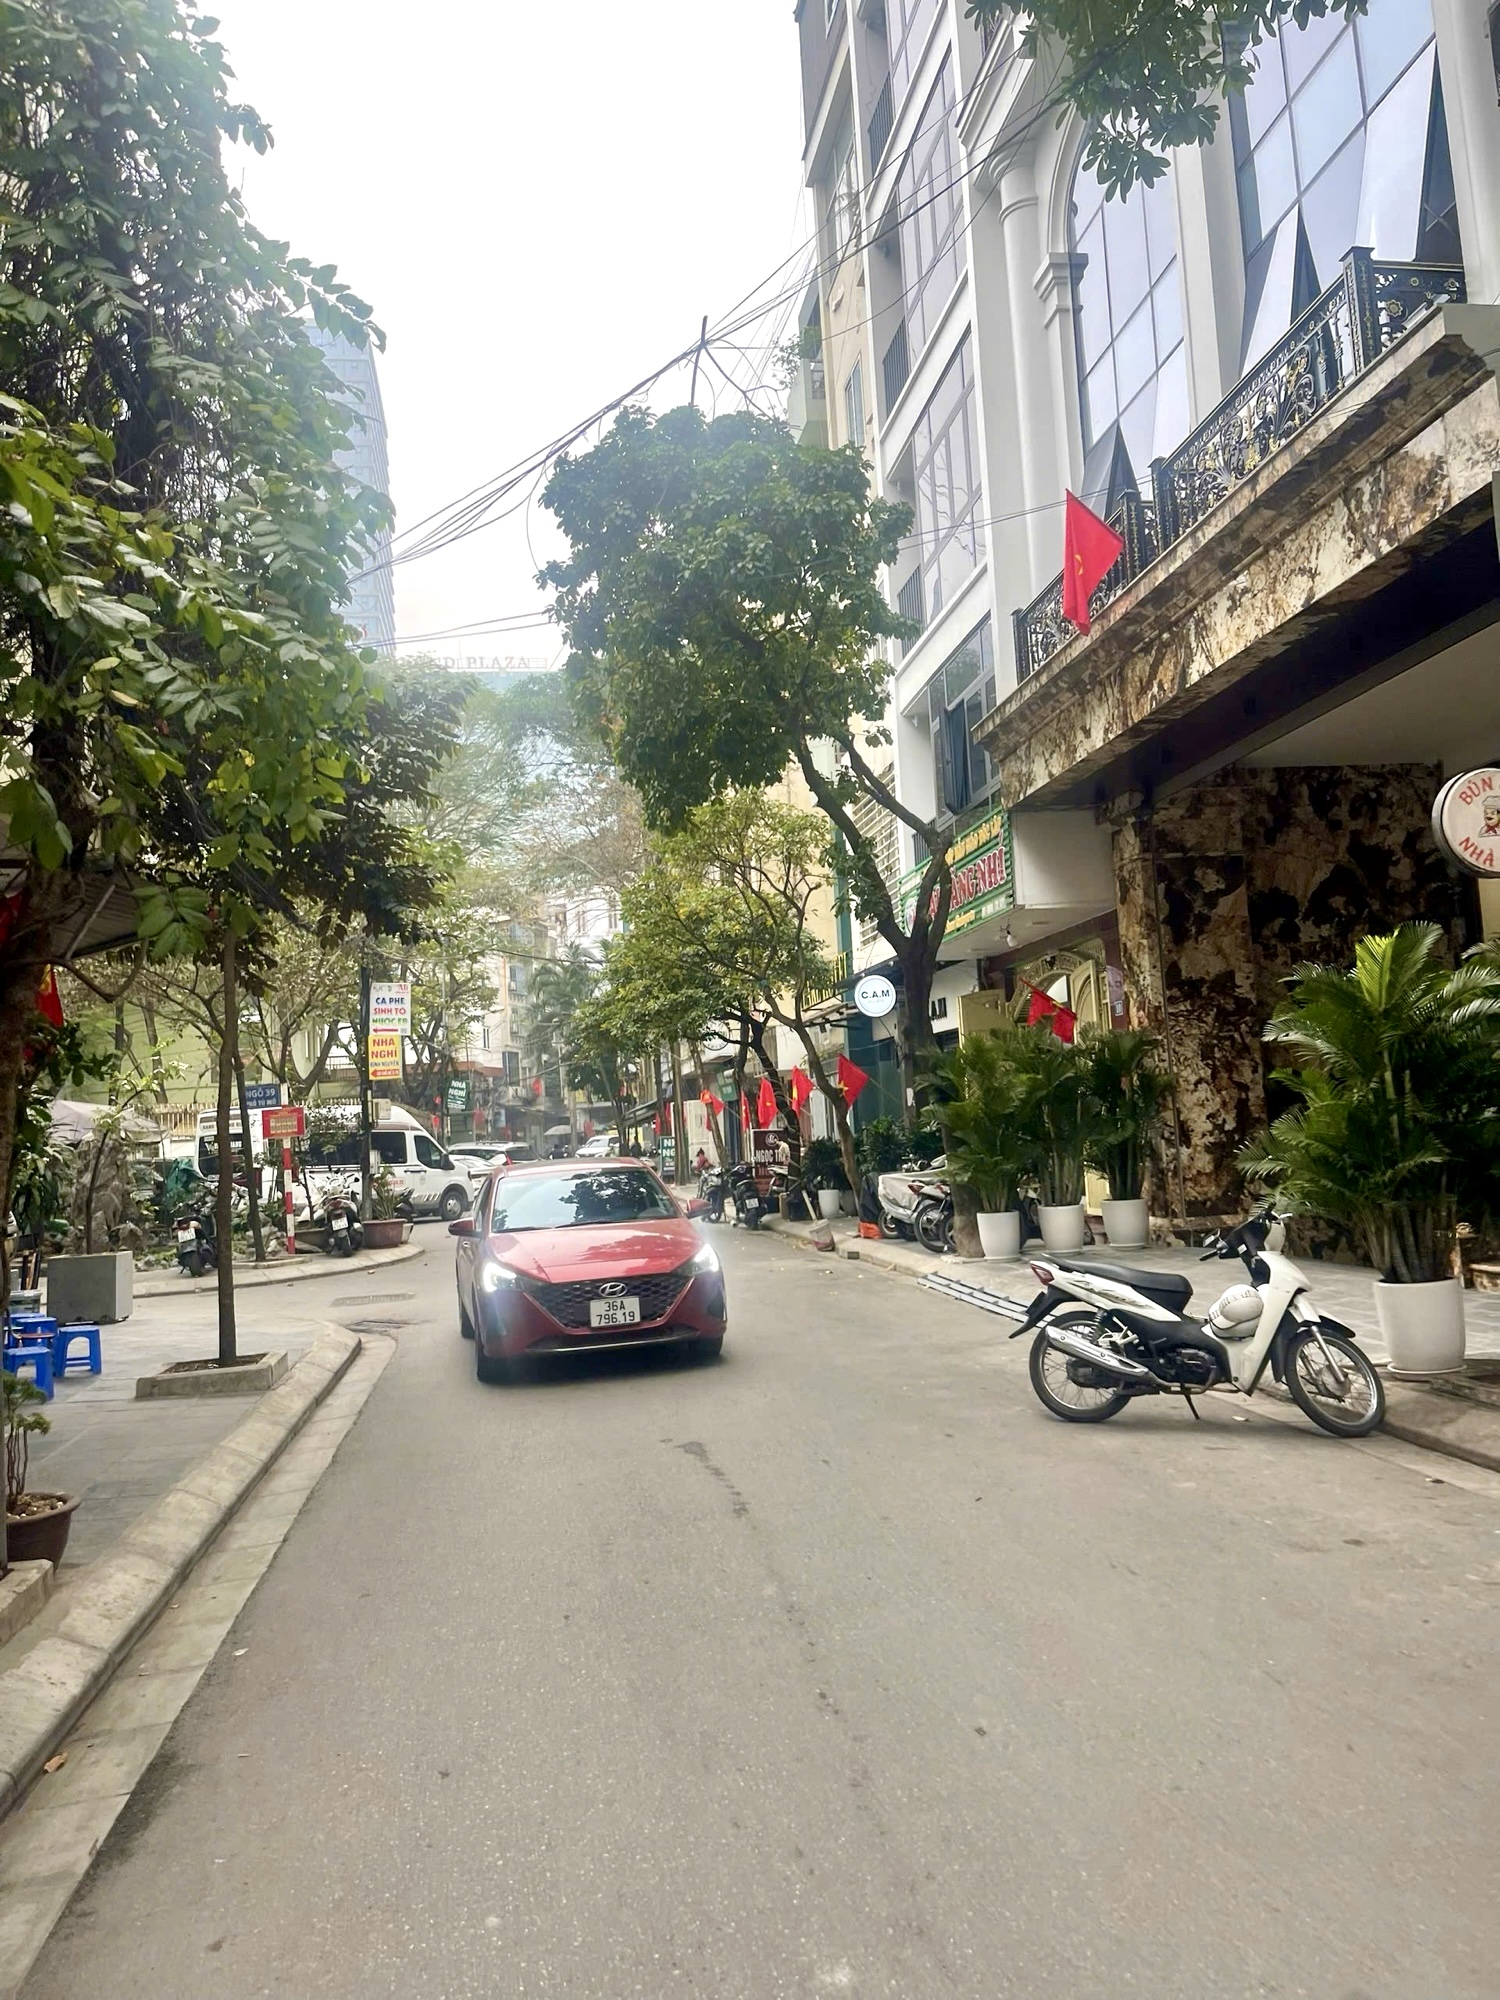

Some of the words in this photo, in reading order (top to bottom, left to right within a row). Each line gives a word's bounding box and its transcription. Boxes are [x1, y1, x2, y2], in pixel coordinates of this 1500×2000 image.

[466, 656, 529, 669] PLAZA
[1458, 776, 1493, 806] BÚN
[1458, 836, 1494, 867] NHÀ
[950, 865, 976, 911] ÀNG
[861, 989, 890, 999] C.A.M
[373, 1007, 392, 1015] SINH
[265, 1088, 275, 1097] 39
[662, 1148, 675, 1157] NG
[604, 1300, 625, 1312] 36A
[596, 1311, 635, 1325] 796.19
